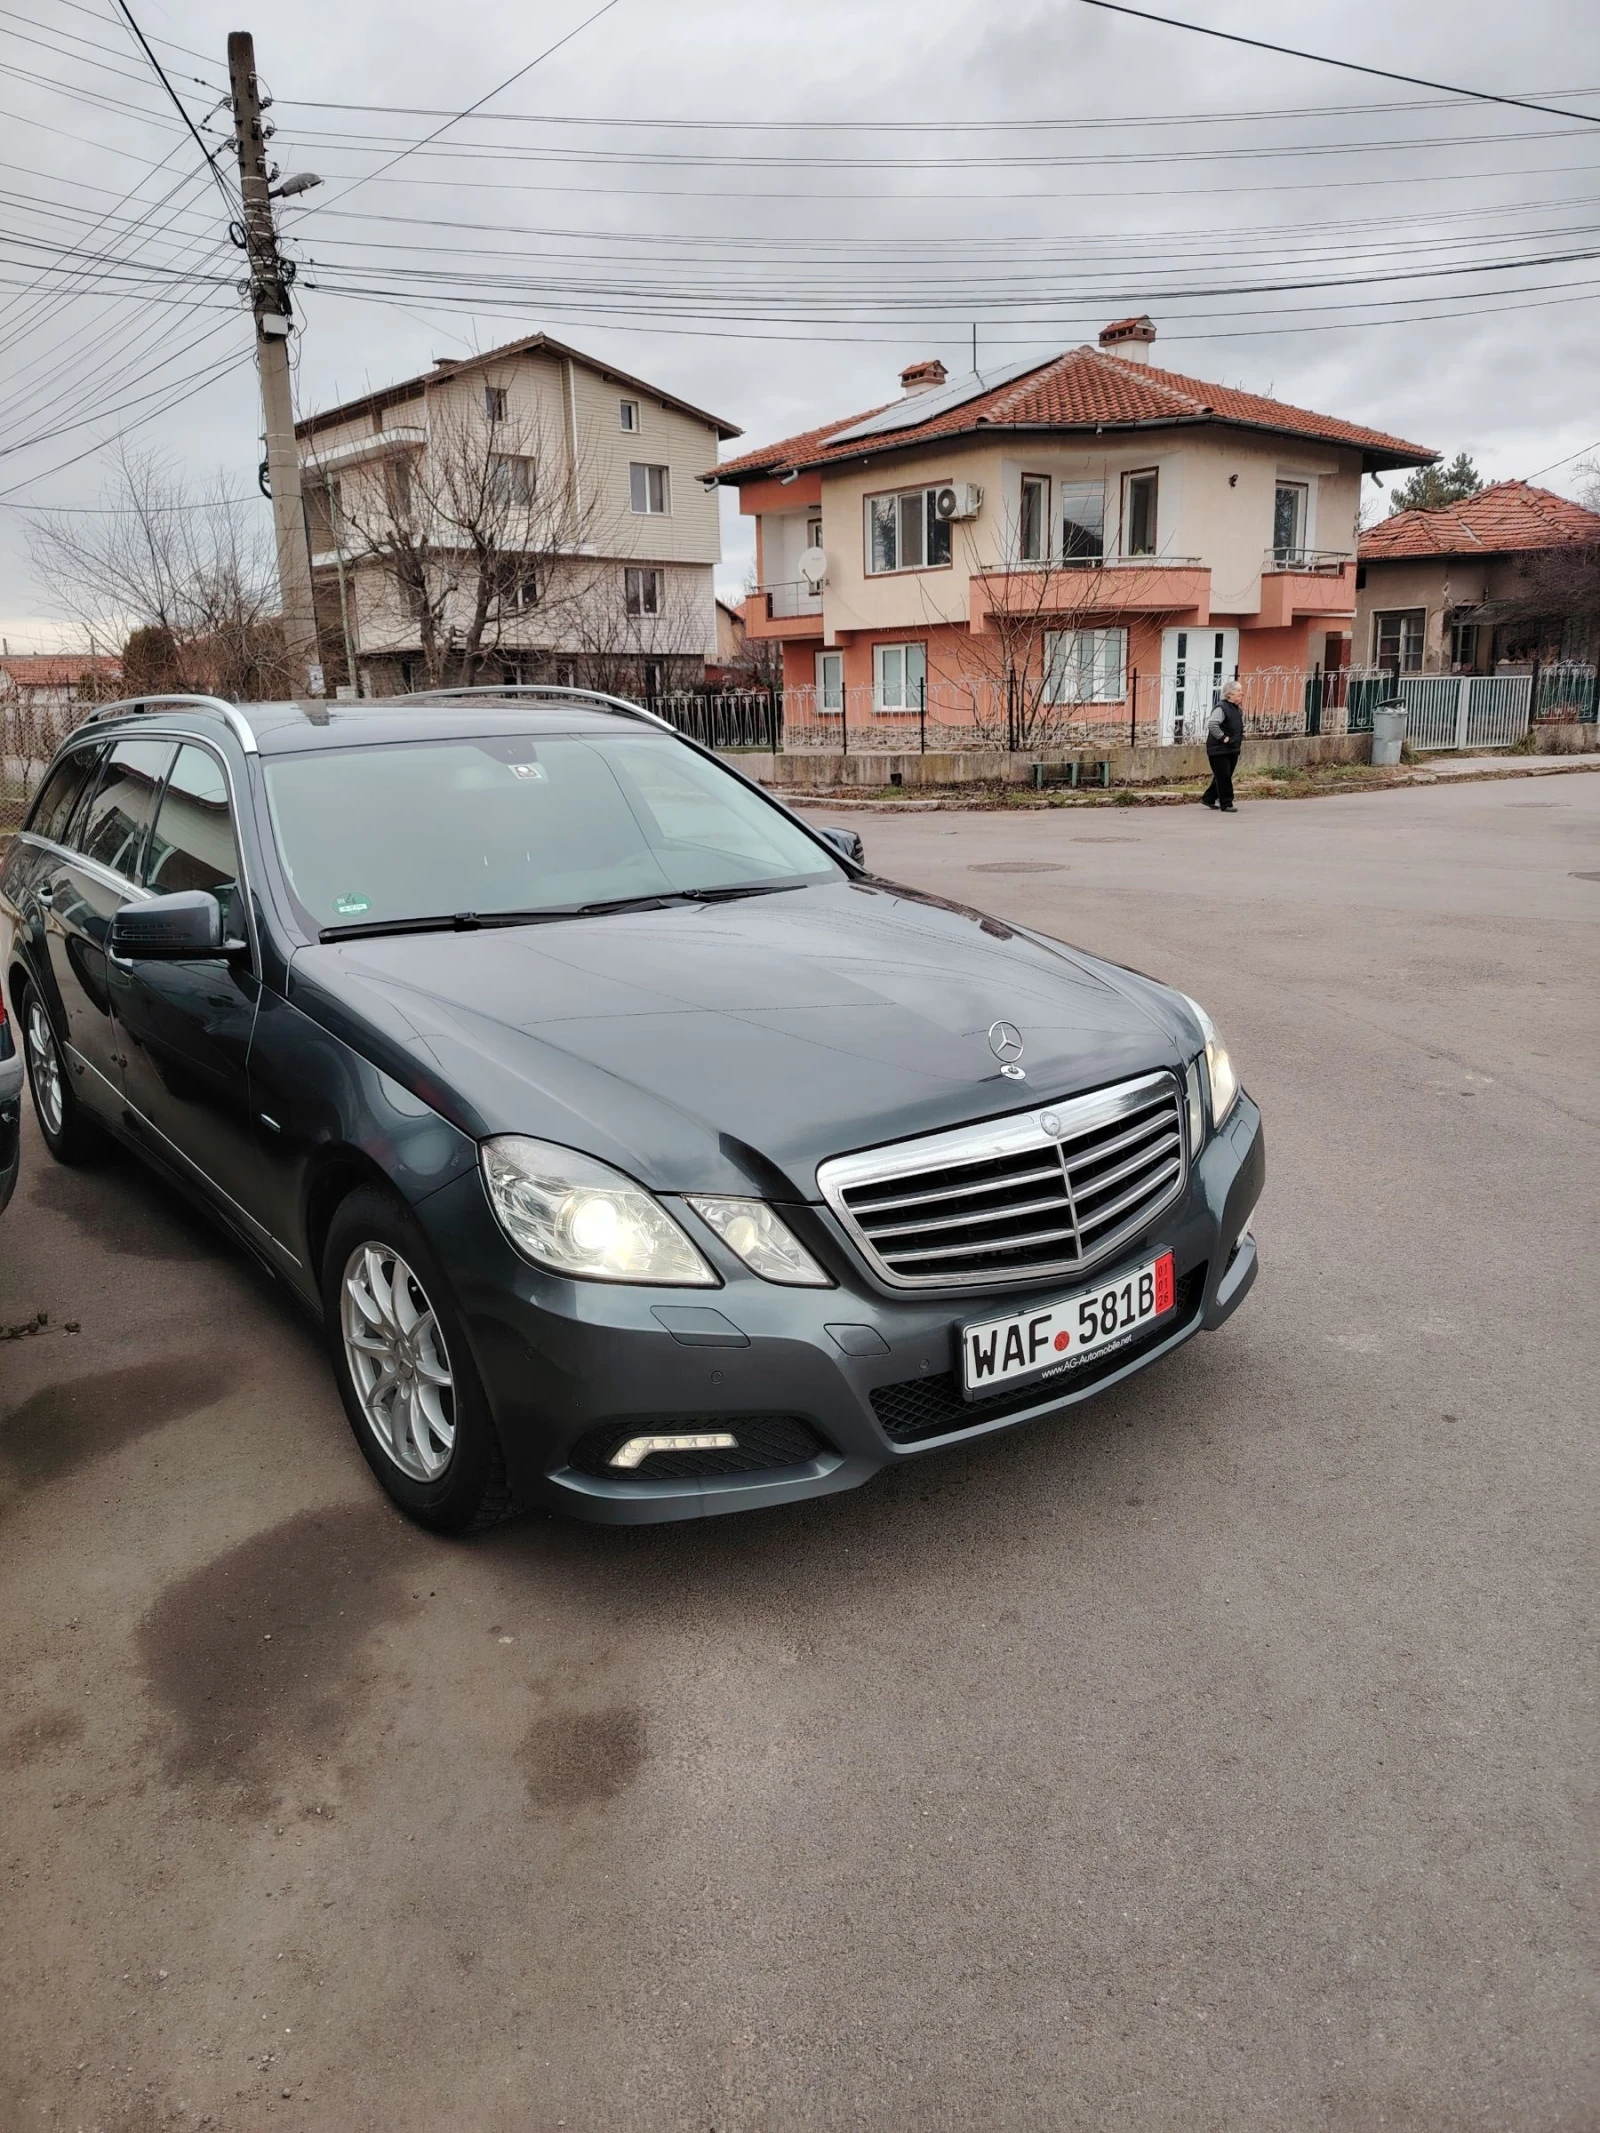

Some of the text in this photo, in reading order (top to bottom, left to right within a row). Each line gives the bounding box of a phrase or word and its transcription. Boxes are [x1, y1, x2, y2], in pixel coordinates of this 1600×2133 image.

[1158, 1261, 1168, 1277] 01
[1158, 1276, 1168, 1292] 01
[1158, 1291, 1169, 1307] 26
[972, 1272, 1154, 1379] WAF 581B
[1041, 1334, 1133, 1379] www.AG-Automobile.net
